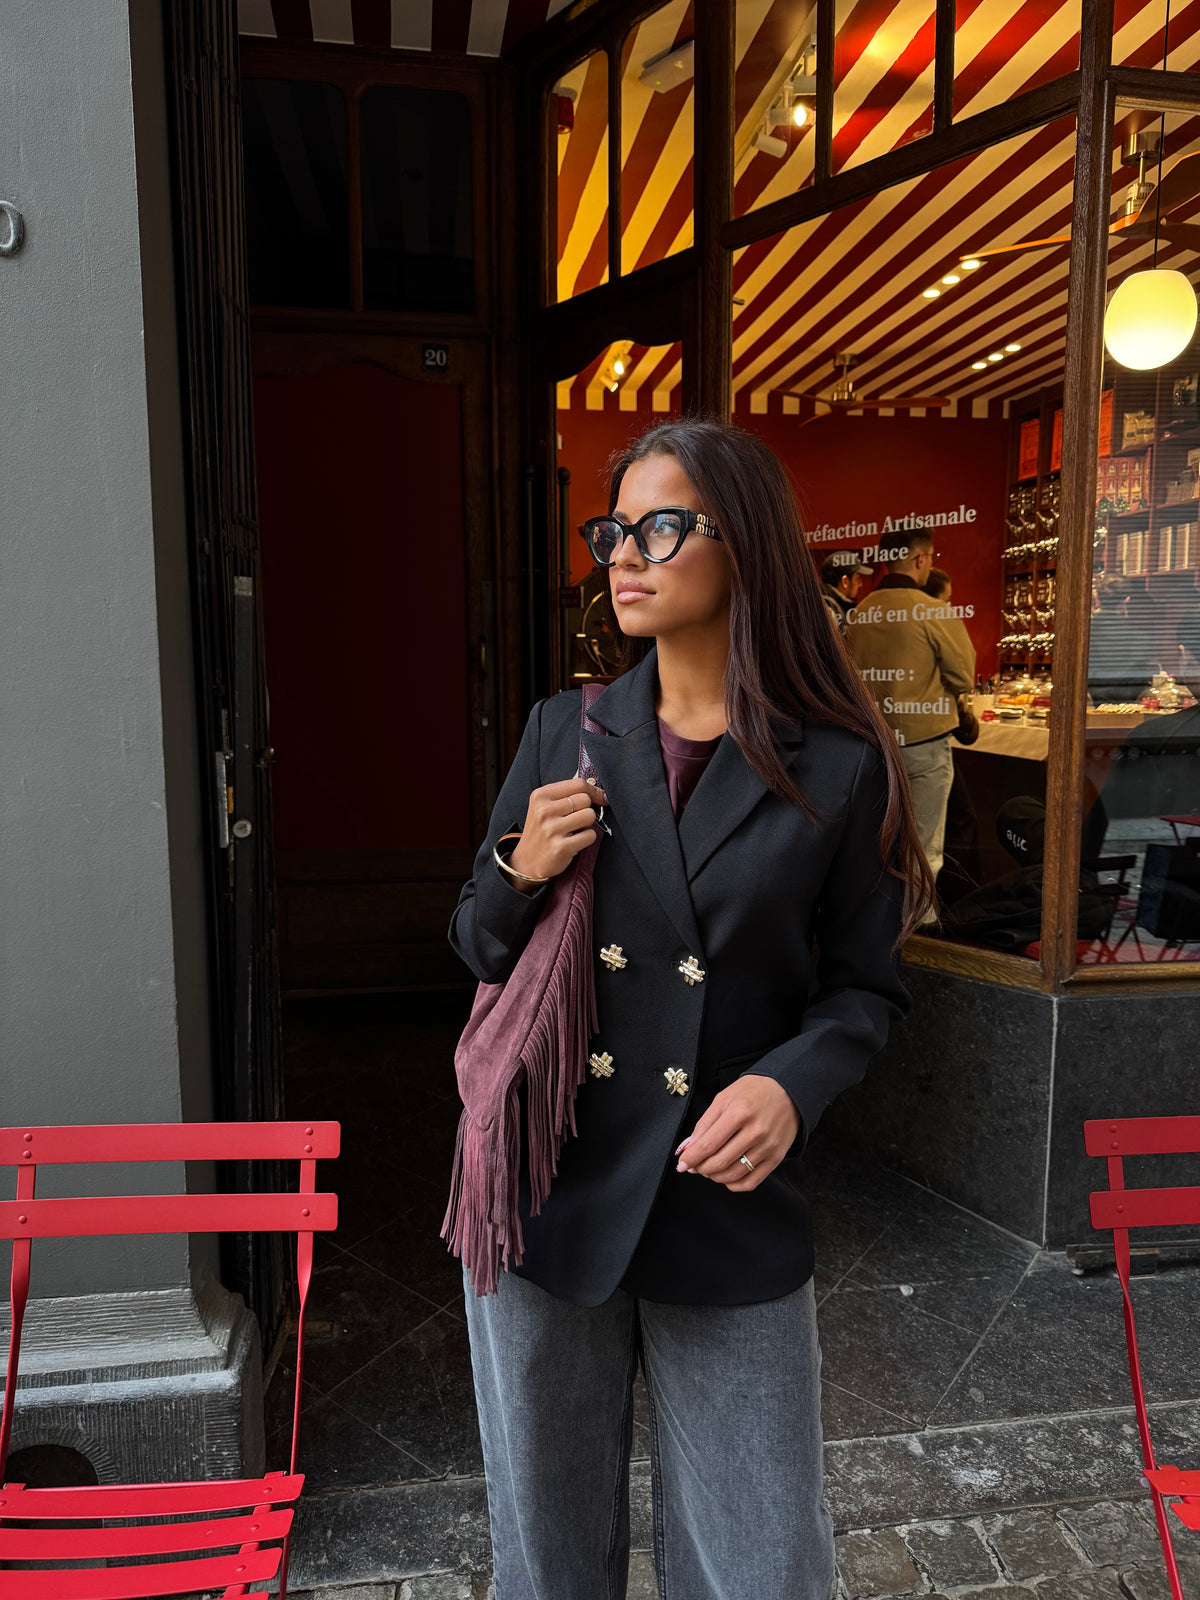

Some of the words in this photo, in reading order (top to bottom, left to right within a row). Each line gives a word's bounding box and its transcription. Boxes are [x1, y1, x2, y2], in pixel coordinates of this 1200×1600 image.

[425, 349, 447, 366] 20
[804, 520, 877, 545] réfaction
[881, 504, 977, 534] Artisanale
[832, 552, 859, 567] sur
[862, 544, 909, 565] Place
[846, 605, 882, 625] Café
[886, 608, 908, 622] en
[912, 602, 975, 621] Grains
[859, 666, 905, 681] rture
[883, 696, 950, 715] Samedi
